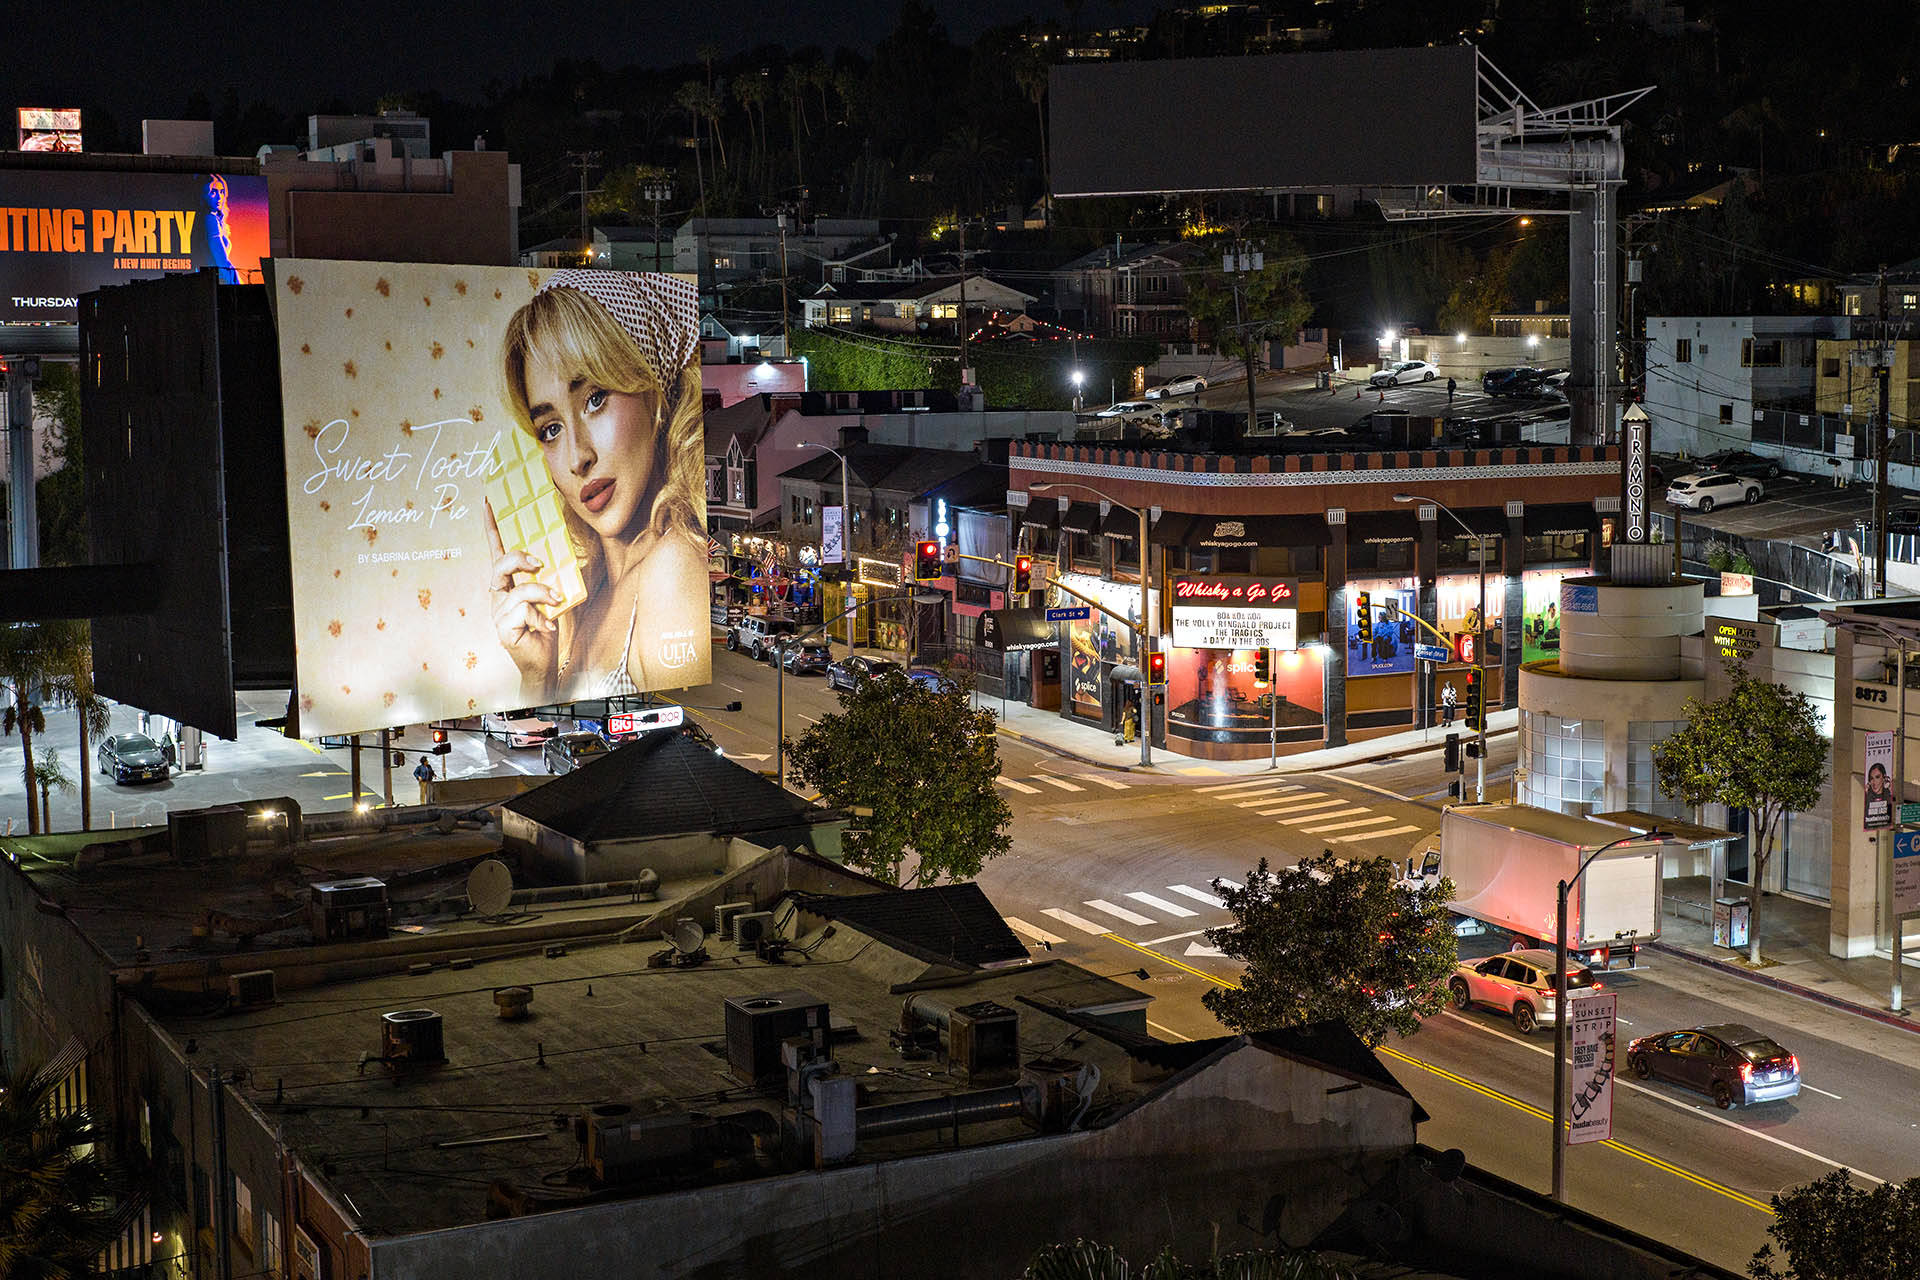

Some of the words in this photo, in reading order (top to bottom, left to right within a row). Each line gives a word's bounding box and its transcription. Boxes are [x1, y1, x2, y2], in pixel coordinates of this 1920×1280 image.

[92, 209, 196, 254] PARTY
[113, 258, 120, 269] A
[121, 258, 139, 270] NEW
[139, 258, 161, 270] HUNT
[162, 258, 192, 270] BEGINS
[11, 297, 78, 308] THURSDAY
[304, 419, 412, 494] Sweet
[410, 418, 505, 491] Tooth
[1627, 426, 1644, 541] TRAMONTO
[347, 484, 424, 531] Lemon
[431, 483, 469, 529] Pie
[1543, 528, 1589, 536] whiskyagogo.com
[1200, 540, 1258, 548] whiskyagogo.com
[1364, 536, 1414, 544] whiskyagogo.com
[357, 553, 371, 564] BY
[371, 551, 411, 563] SABRINA
[411, 547, 462, 561] CARPENTER
[1176, 581, 1230, 600] Whisky
[1232, 586, 1243, 597] a
[1246, 583, 1267, 603] Go
[1270, 583, 1291, 603] Go
[1175, 619, 1189, 627] THE
[1259, 621, 1291, 629] PROJECT
[1215, 629, 1228, 637] THE
[1231, 629, 1263, 638] TRAGICS
[1719, 625, 1737, 635] OPEN
[1006, 641, 1059, 651] whiskyagogo.com
[1209, 637, 1225, 645] DAY
[1228, 637, 1237, 645] IN
[1240, 637, 1253, 645] THE
[1713, 635, 1730, 646] WITH
[663, 641, 697, 661] ULTA
[1721, 647, 1732, 657] ON
[1081, 682, 1097, 692] splice
[1856, 686, 1887, 703] 8873
[611, 716, 632, 733] BIG
[635, 711, 680, 727] OOOR
[1868, 749, 1891, 757] STRIP
[1575, 1007, 1612, 1018] SUNSET
[1575, 1021, 1612, 1032] STRIP
